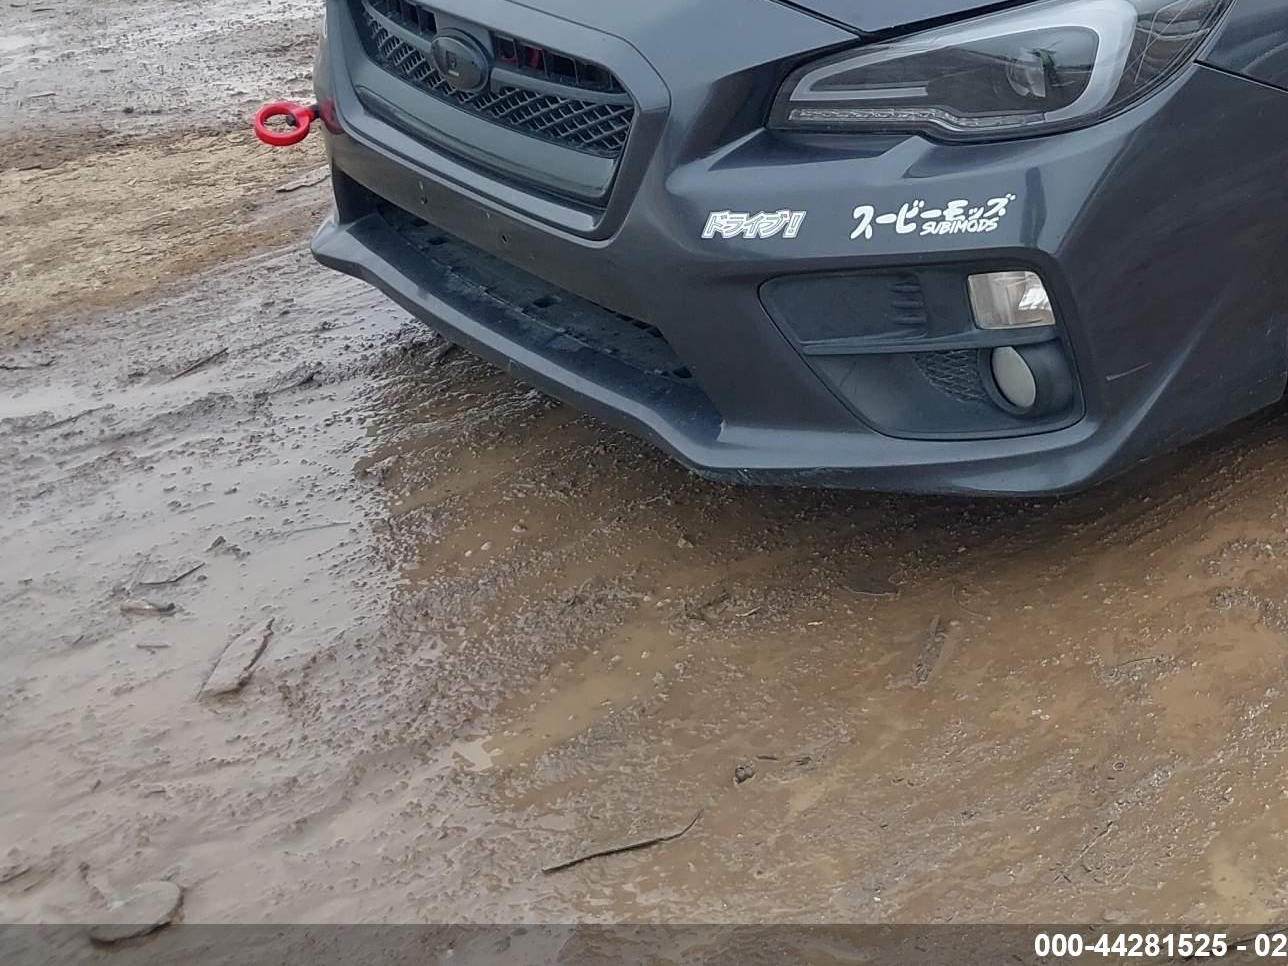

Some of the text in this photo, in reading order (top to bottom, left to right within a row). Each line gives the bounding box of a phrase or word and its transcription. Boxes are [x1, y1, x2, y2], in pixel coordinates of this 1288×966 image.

[849, 193, 1017, 240] スービーモッズ
[919, 216, 1000, 236] SUBIMODS
